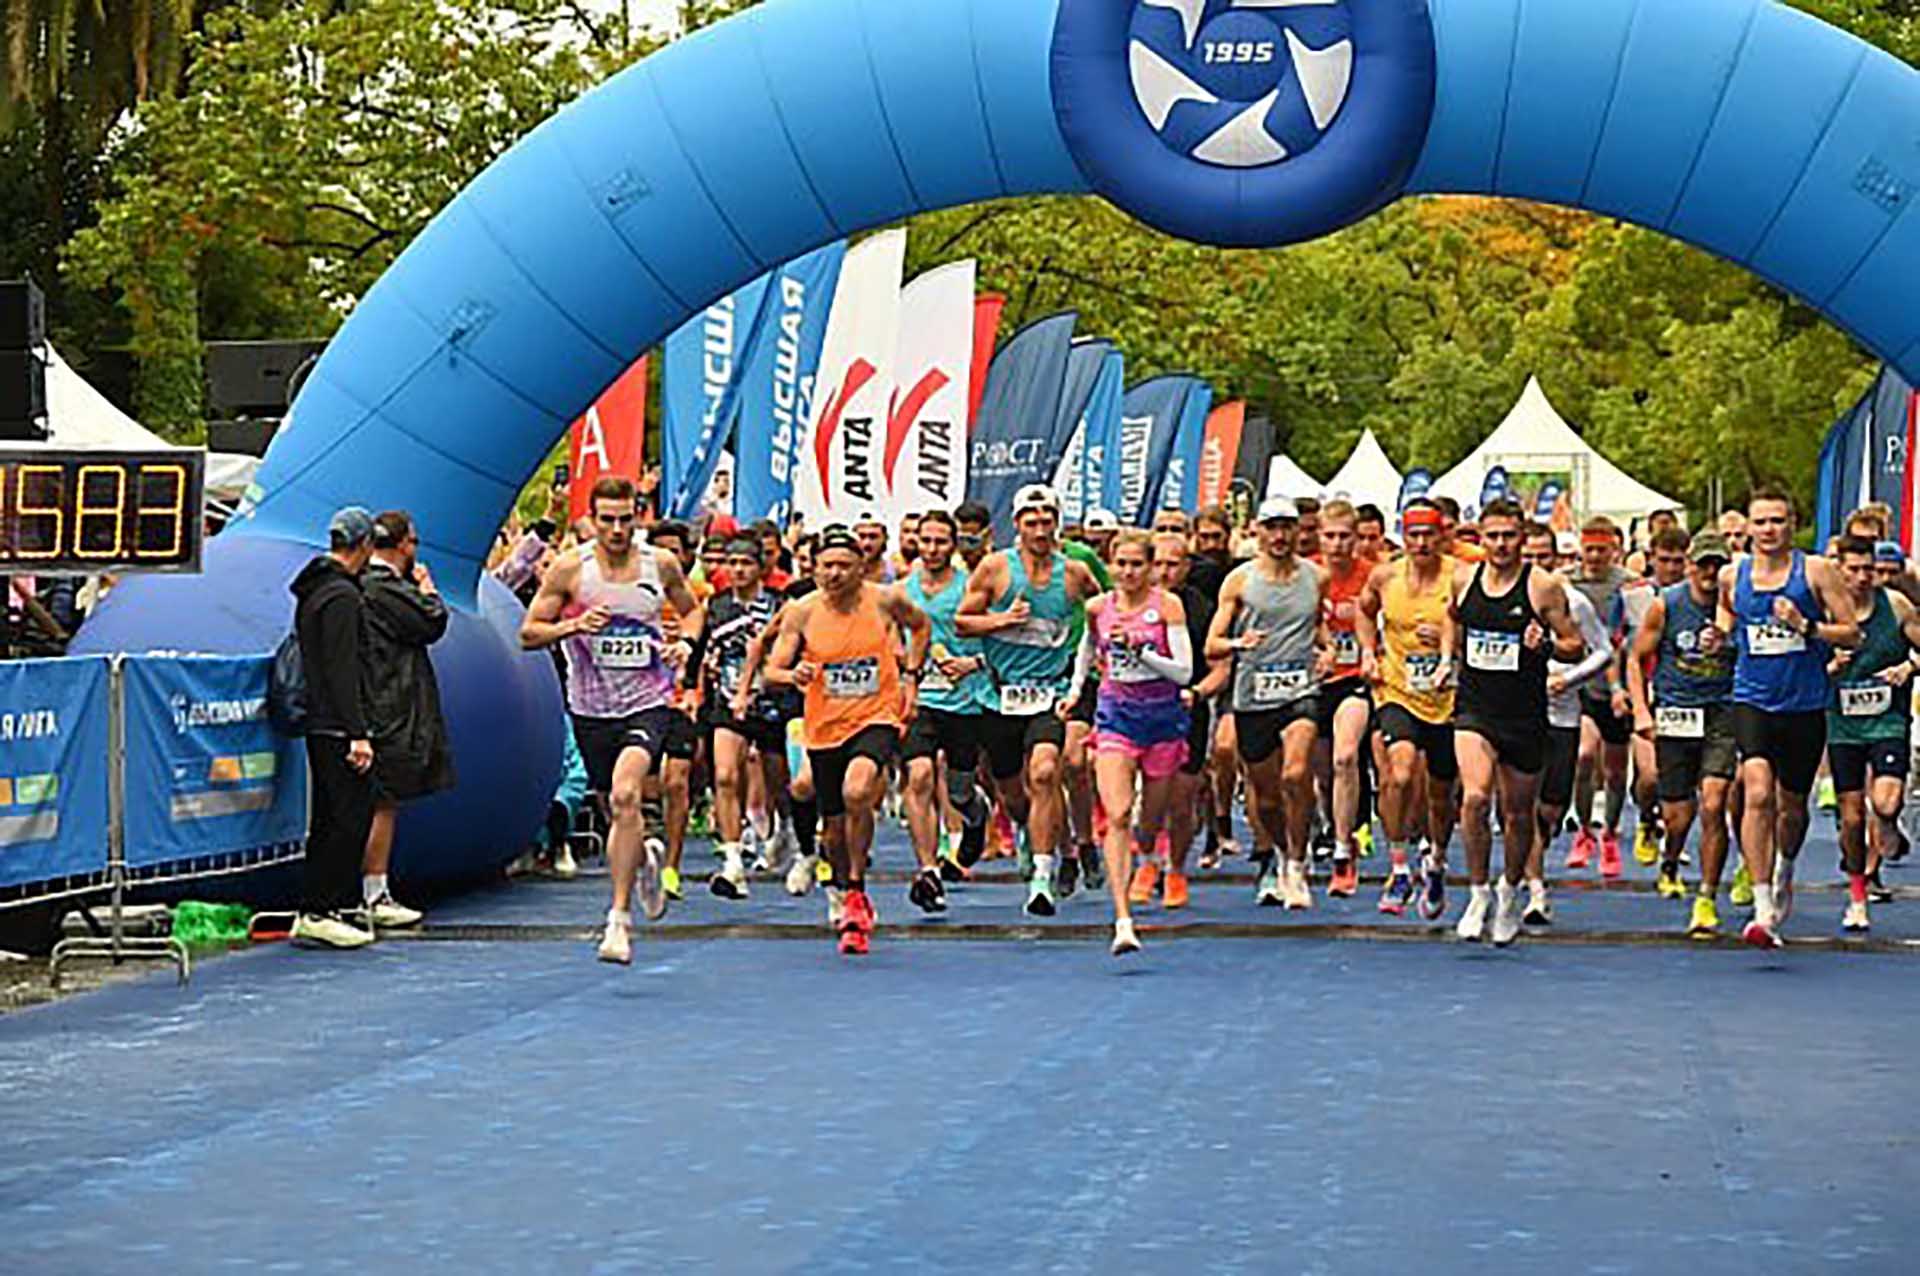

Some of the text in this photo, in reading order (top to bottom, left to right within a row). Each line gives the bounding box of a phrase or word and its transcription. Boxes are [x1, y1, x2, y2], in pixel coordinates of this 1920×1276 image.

[1205, 42, 1273, 63] 1995
[771, 276, 804, 482] ВЫСШАЯ
[843, 417, 874, 501] ANTA
[918, 421, 950, 501] ANTA
